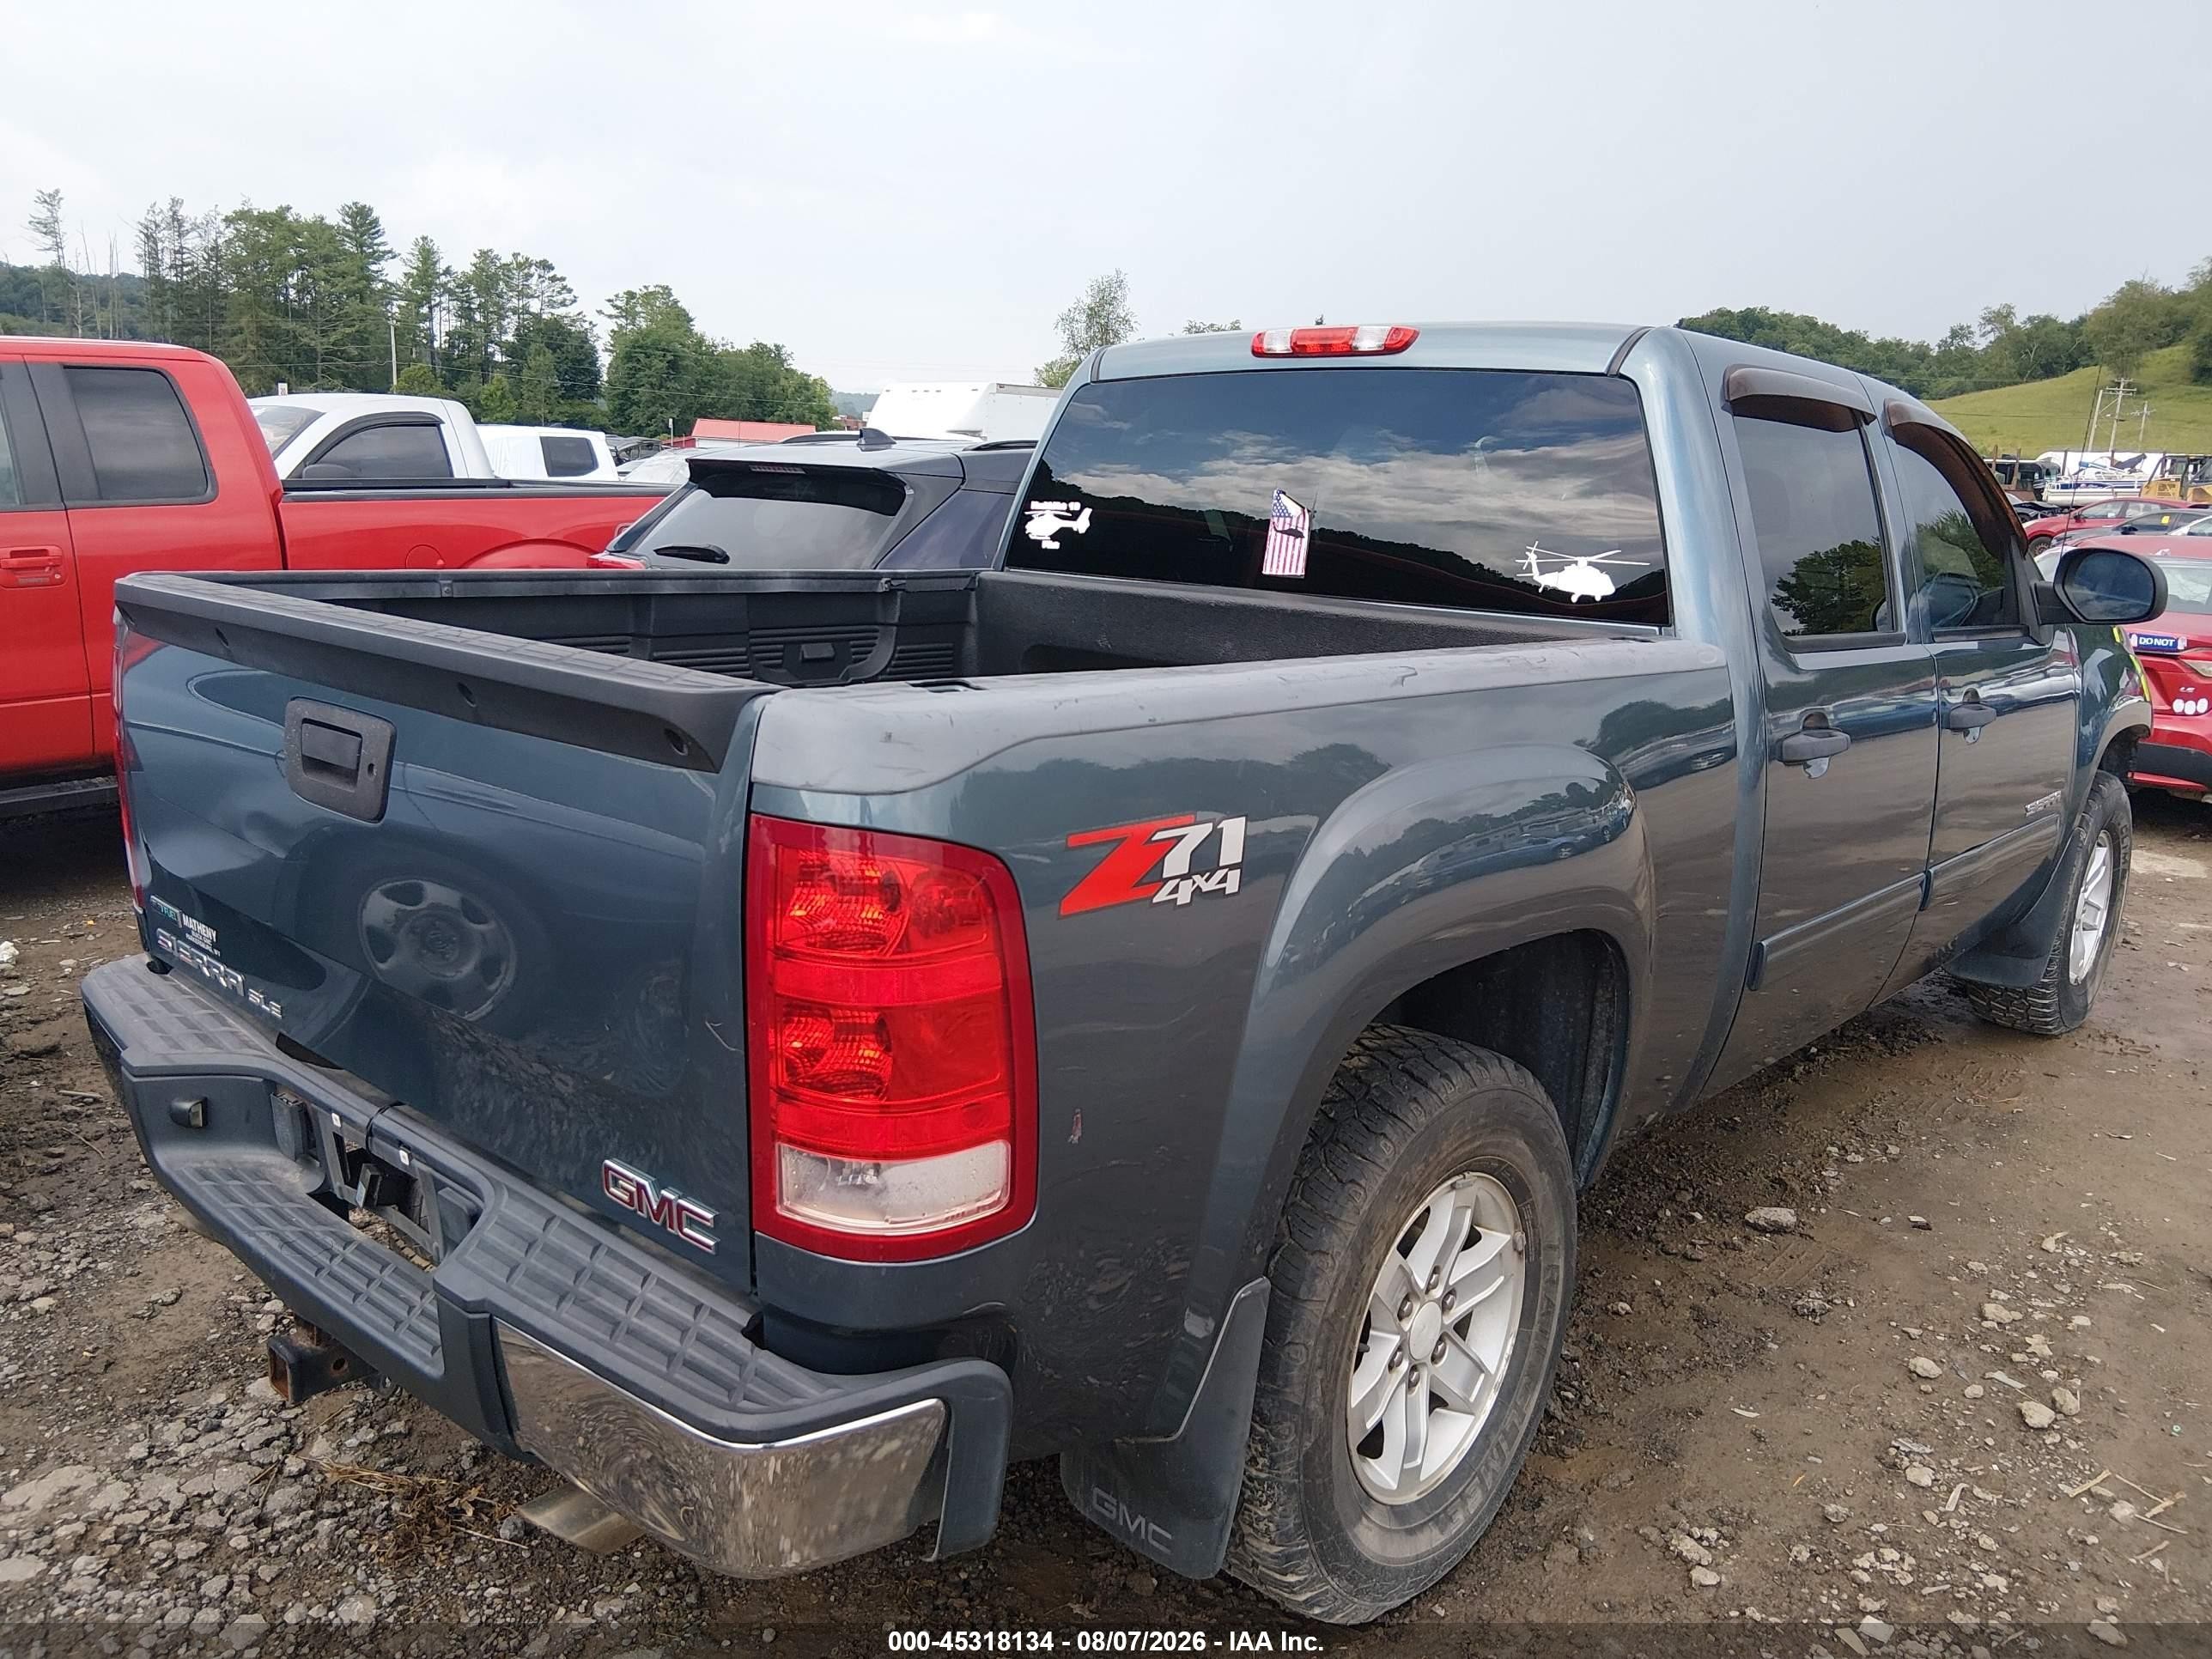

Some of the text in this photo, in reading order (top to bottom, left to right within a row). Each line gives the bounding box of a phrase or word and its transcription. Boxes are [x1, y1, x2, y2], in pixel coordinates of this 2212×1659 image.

[2139, 636, 2176, 647] DO NOT
[1059, 812, 1247, 918] Z71
[182, 913, 217, 943] MATHENY
[156, 927, 283, 1019] SIERRA SLE
[602, 1158, 720, 1255] GMC
[1091, 1486, 1173, 1555] GMC
